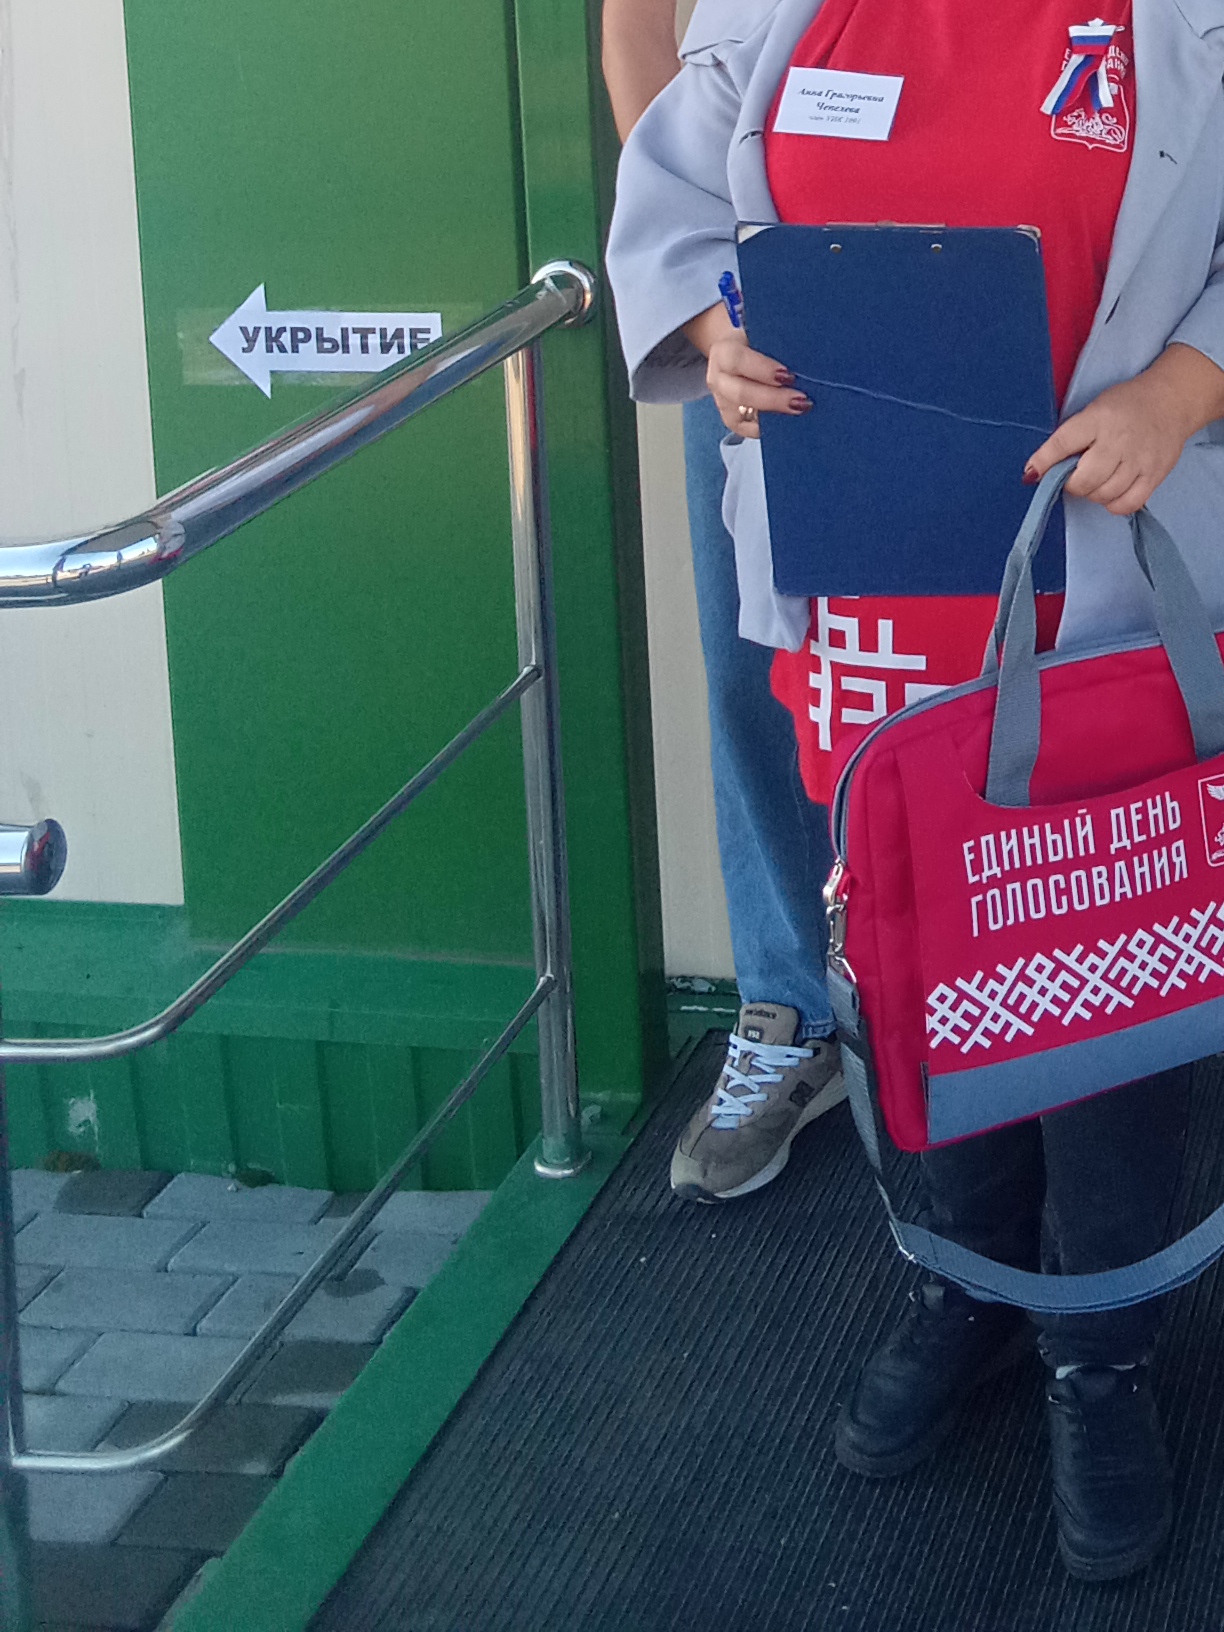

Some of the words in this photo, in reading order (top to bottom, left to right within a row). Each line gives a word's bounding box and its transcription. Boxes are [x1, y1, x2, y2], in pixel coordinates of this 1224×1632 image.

[825, 89, 886, 103] Григорьевна
[239, 325, 432, 355] УКРЫТИЕ
[962, 809, 1096, 884] ЕДИНЫЙ
[1109, 790, 1182, 855] ДЕНЬ
[970, 839, 1189, 938] ГОЛОСОВАНИЯ
